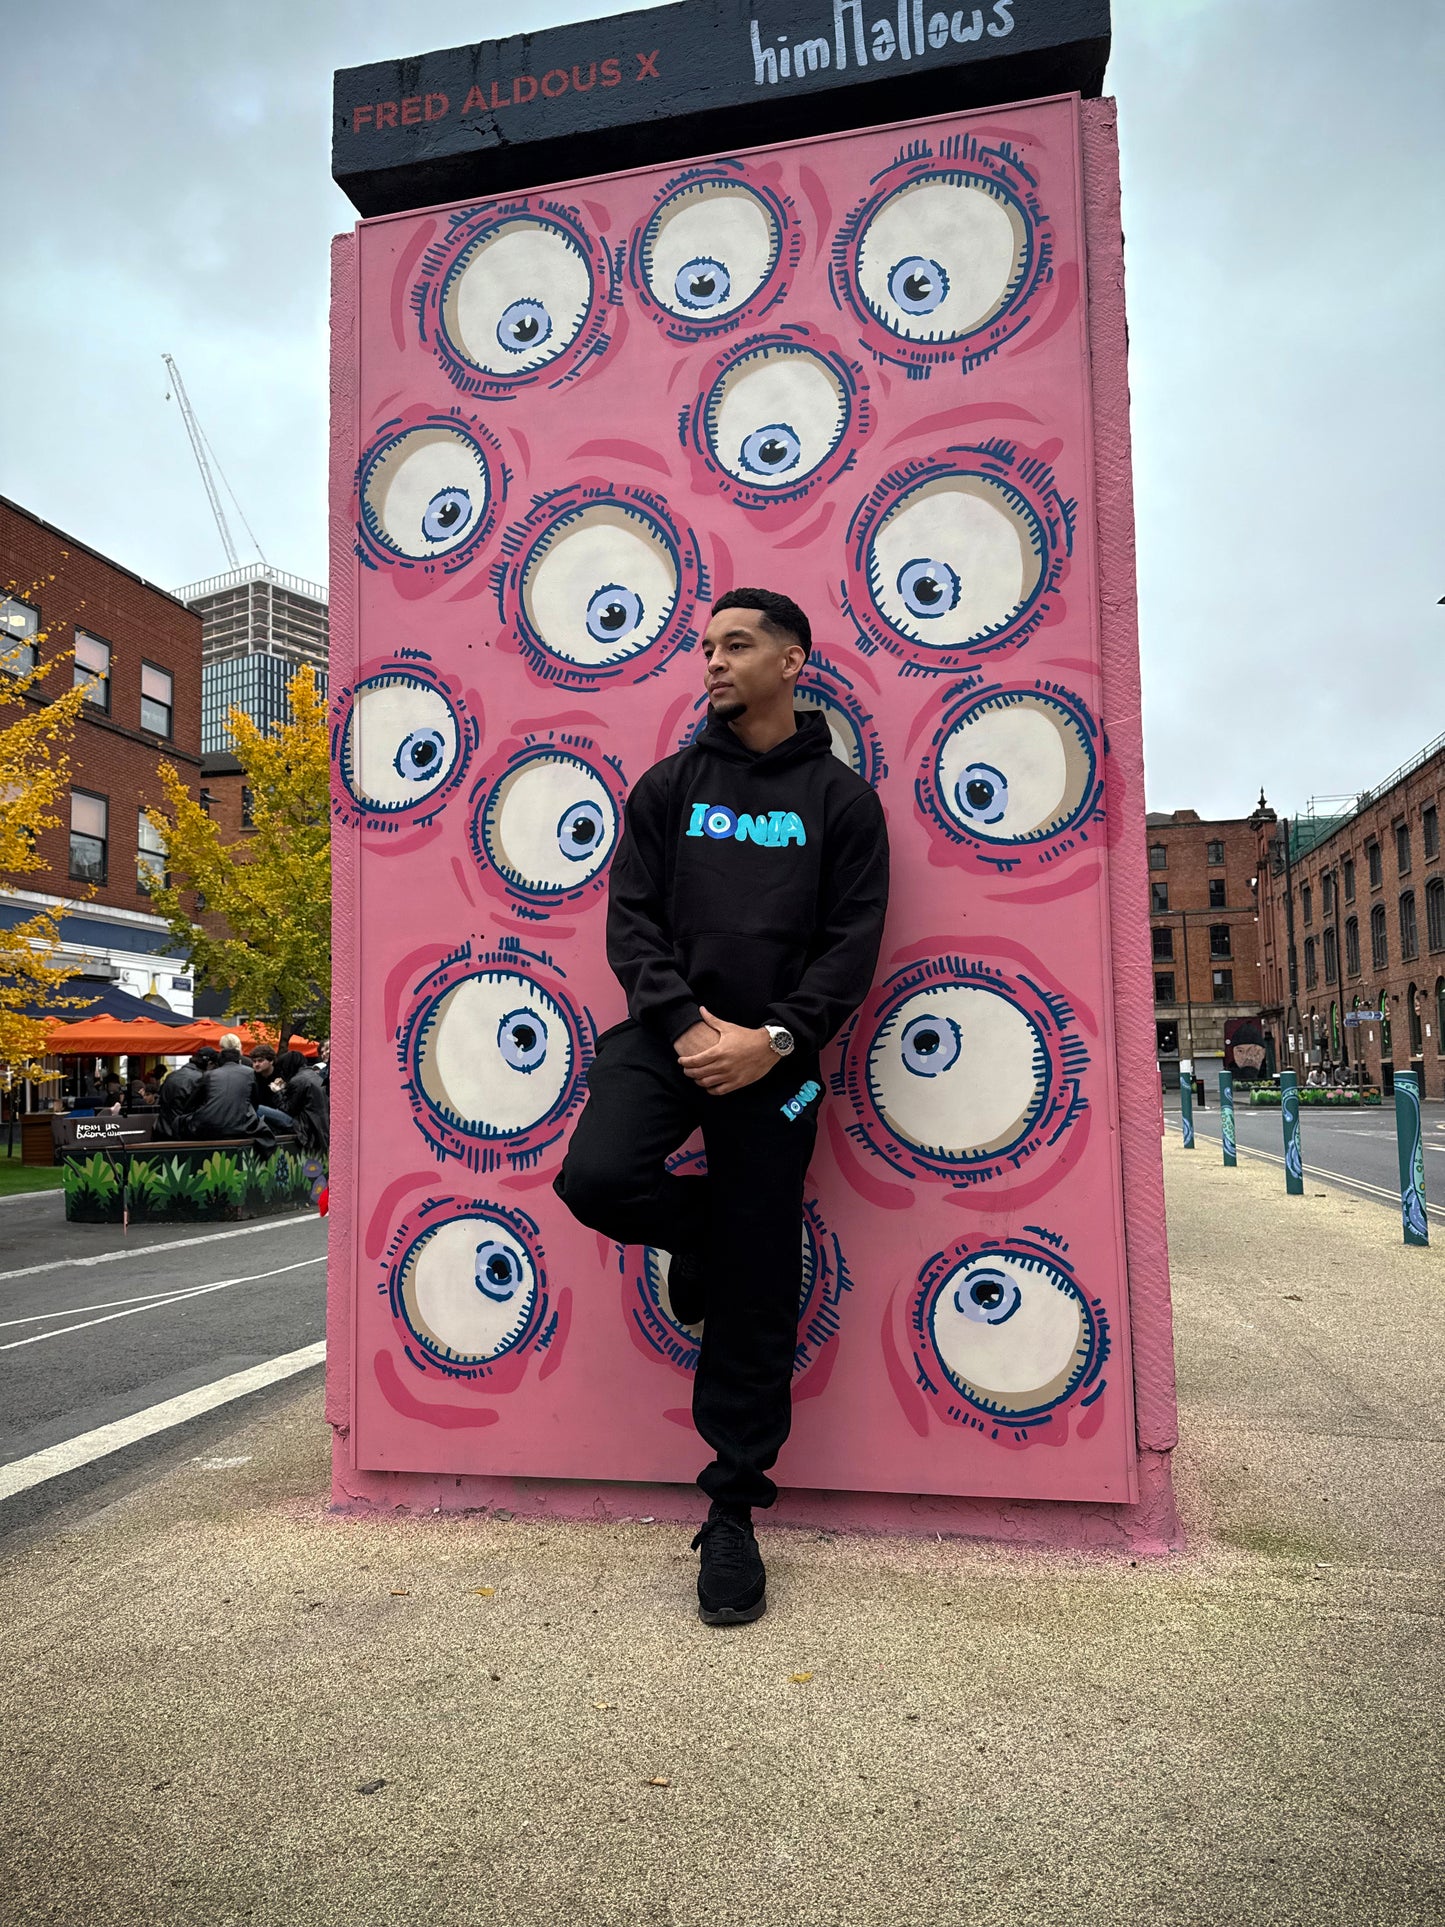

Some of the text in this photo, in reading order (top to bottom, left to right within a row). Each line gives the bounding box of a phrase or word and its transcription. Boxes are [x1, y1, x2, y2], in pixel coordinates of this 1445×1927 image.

[352, 49, 660, 134] FRED ALDOUS X
[686, 803, 806, 847] IONIA
